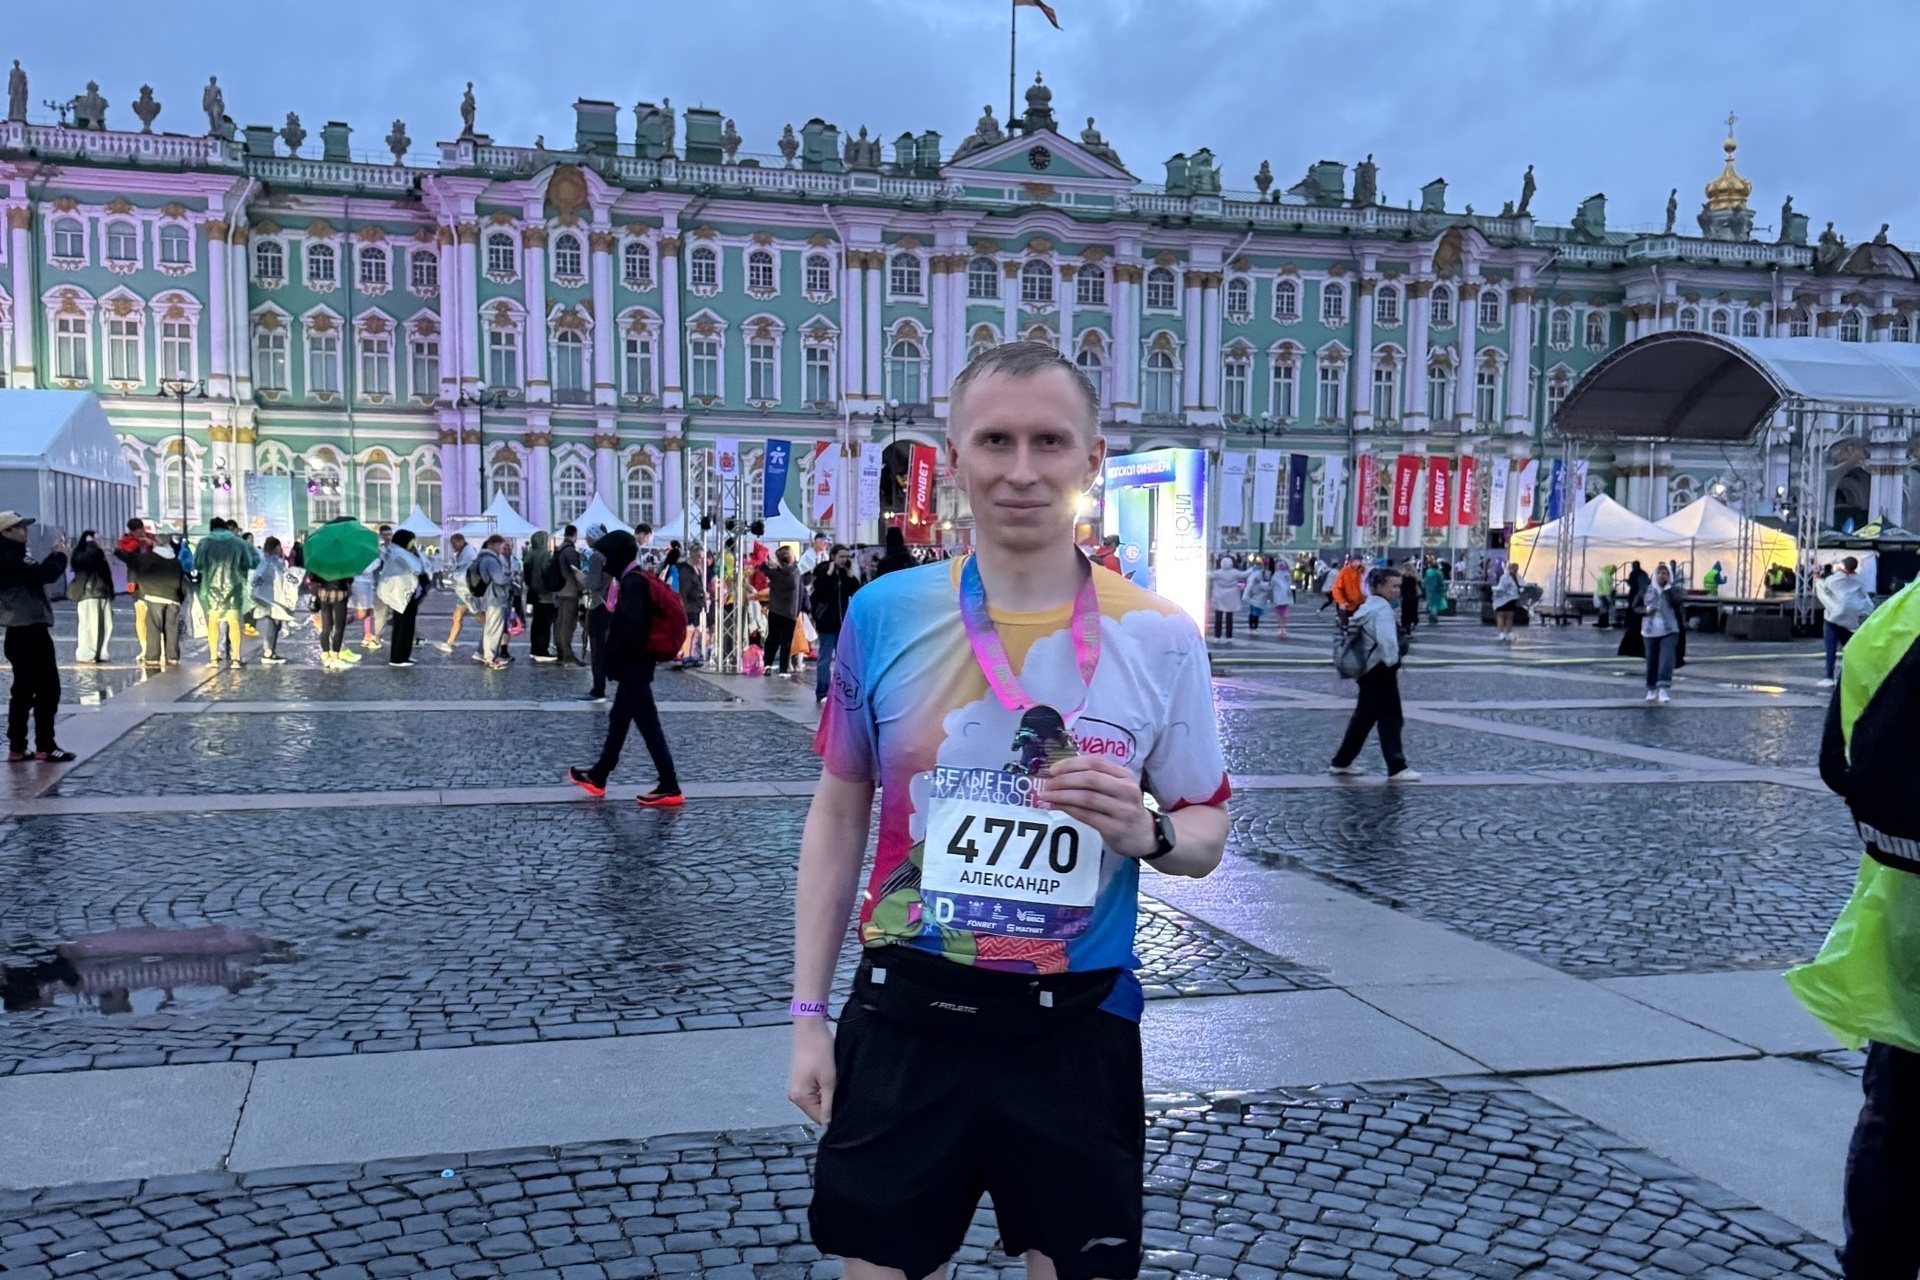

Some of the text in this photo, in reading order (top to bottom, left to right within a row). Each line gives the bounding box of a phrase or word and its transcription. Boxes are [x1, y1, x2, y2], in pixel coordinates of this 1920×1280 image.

[917, 460, 930, 510] FONBET
[1433, 469, 1446, 515] FONBET
[935, 768, 994, 790] БЕЛЫЕ
[937, 786, 1034, 807] МАРАФОН
[947, 815, 1079, 874] 4770
[1858, 821, 1920, 862] PUM
[960, 870, 1060, 895] АЛЕКСАНДР
[935, 897, 955, 923] D
[966, 919, 998, 929] FONBET
